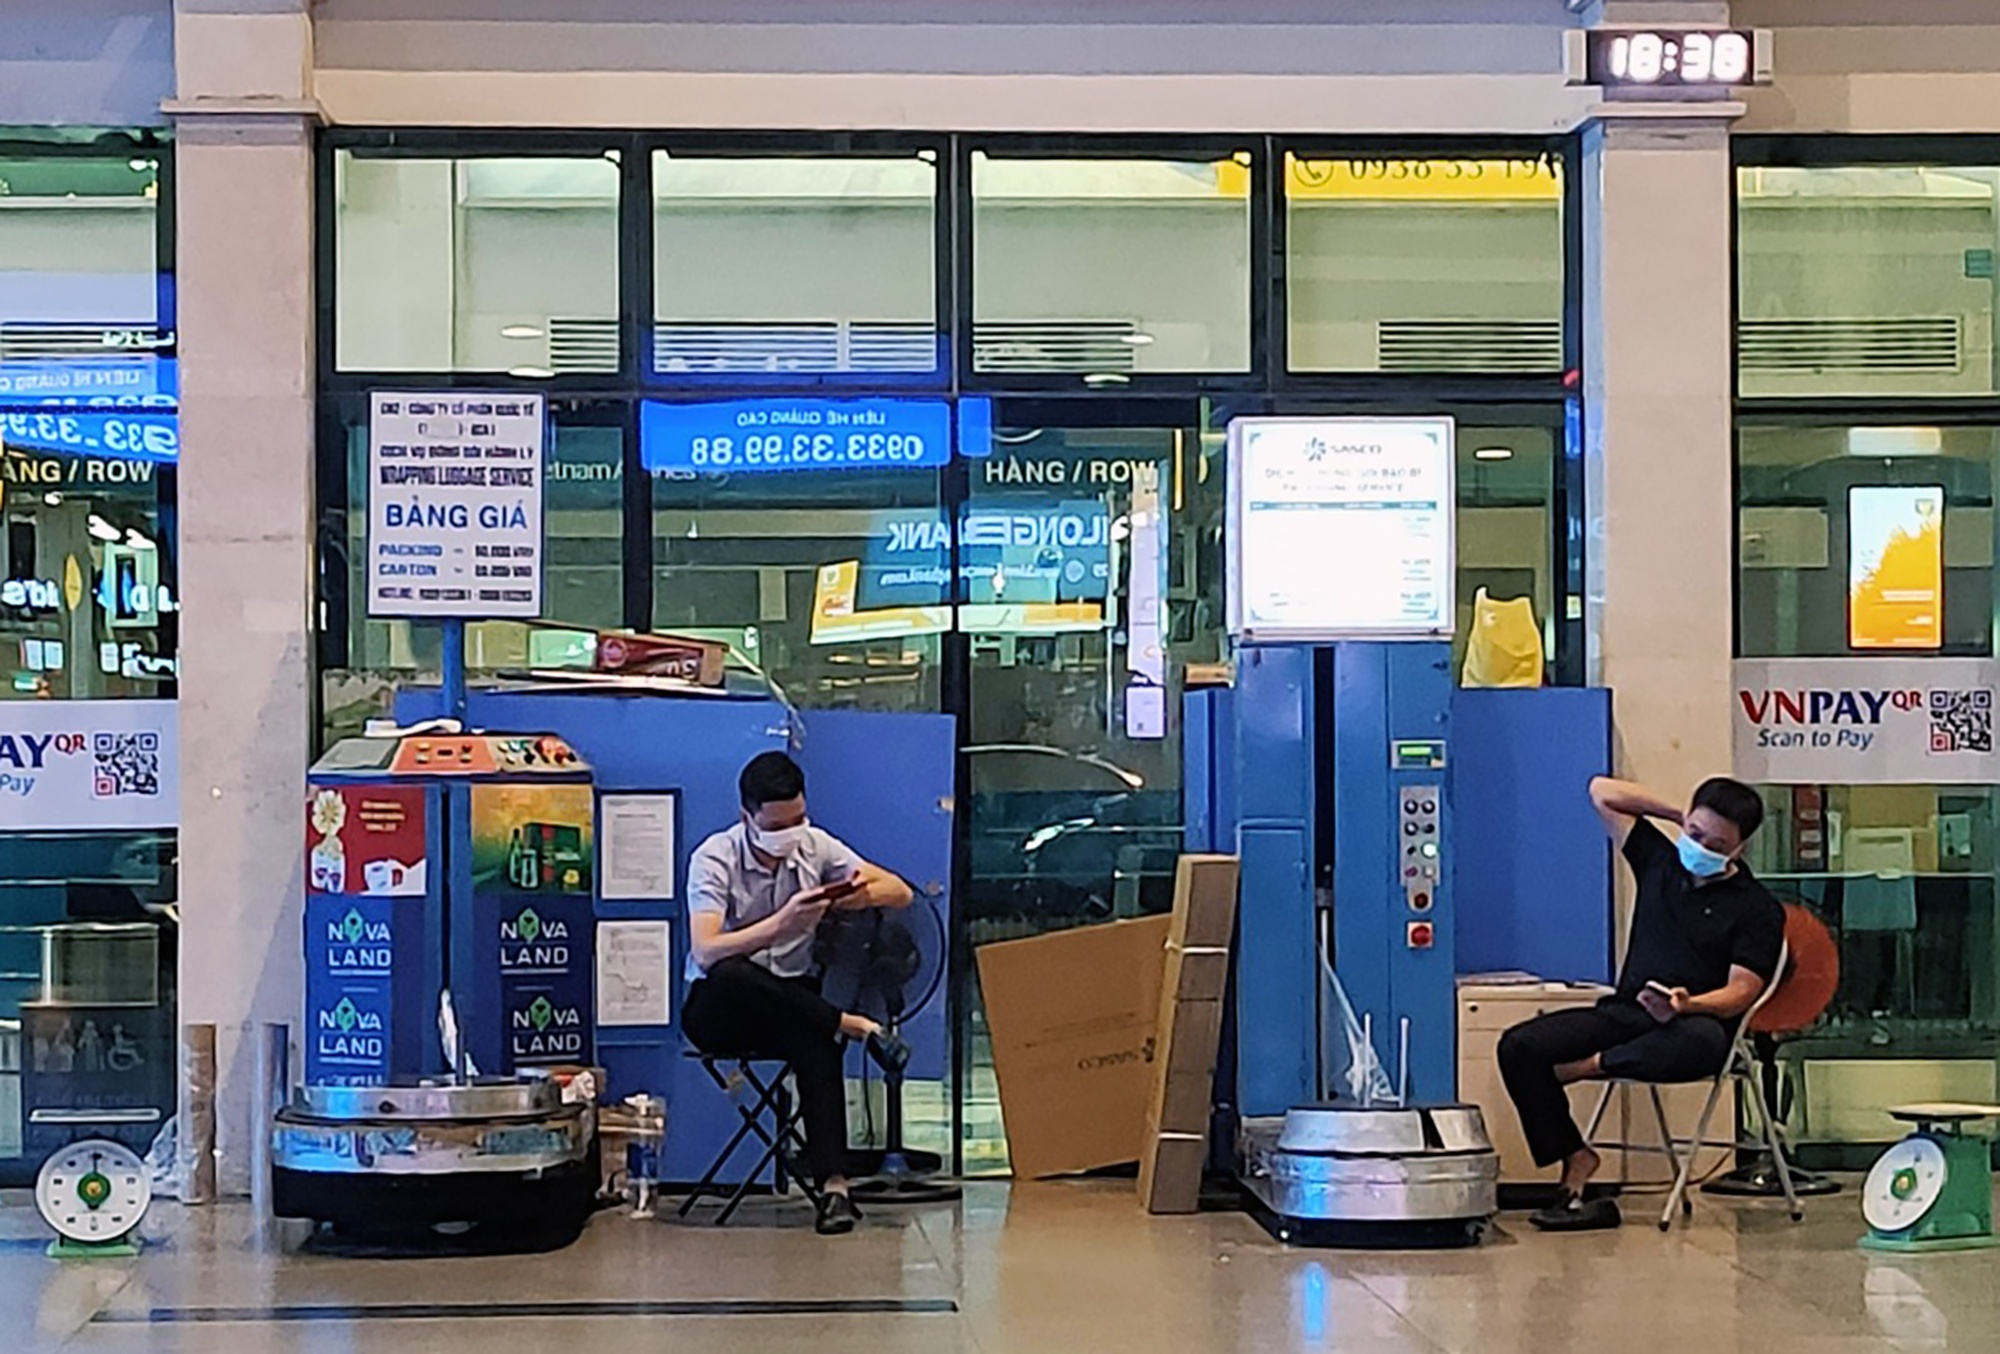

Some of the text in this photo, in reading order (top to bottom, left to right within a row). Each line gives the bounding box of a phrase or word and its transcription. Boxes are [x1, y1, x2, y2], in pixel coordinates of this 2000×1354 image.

[1611, 33, 1749, 82] 18:38
[87, 459, 153, 483] ROW
[985, 455, 1065, 483] HÀNG
[1090, 460, 1156, 483] ROW
[386, 495, 528, 529] BẢNG GIÁ
[1739, 690, 1923, 725] VNPAY QR
[54, 733, 87, 755] QR
[1757, 728, 1874, 752] Scan to Pay
[328, 949, 392, 967] LAND
[501, 947, 569, 967] LAND
[319, 1035, 383, 1057] LAND
[513, 1033, 582, 1054] LAND
